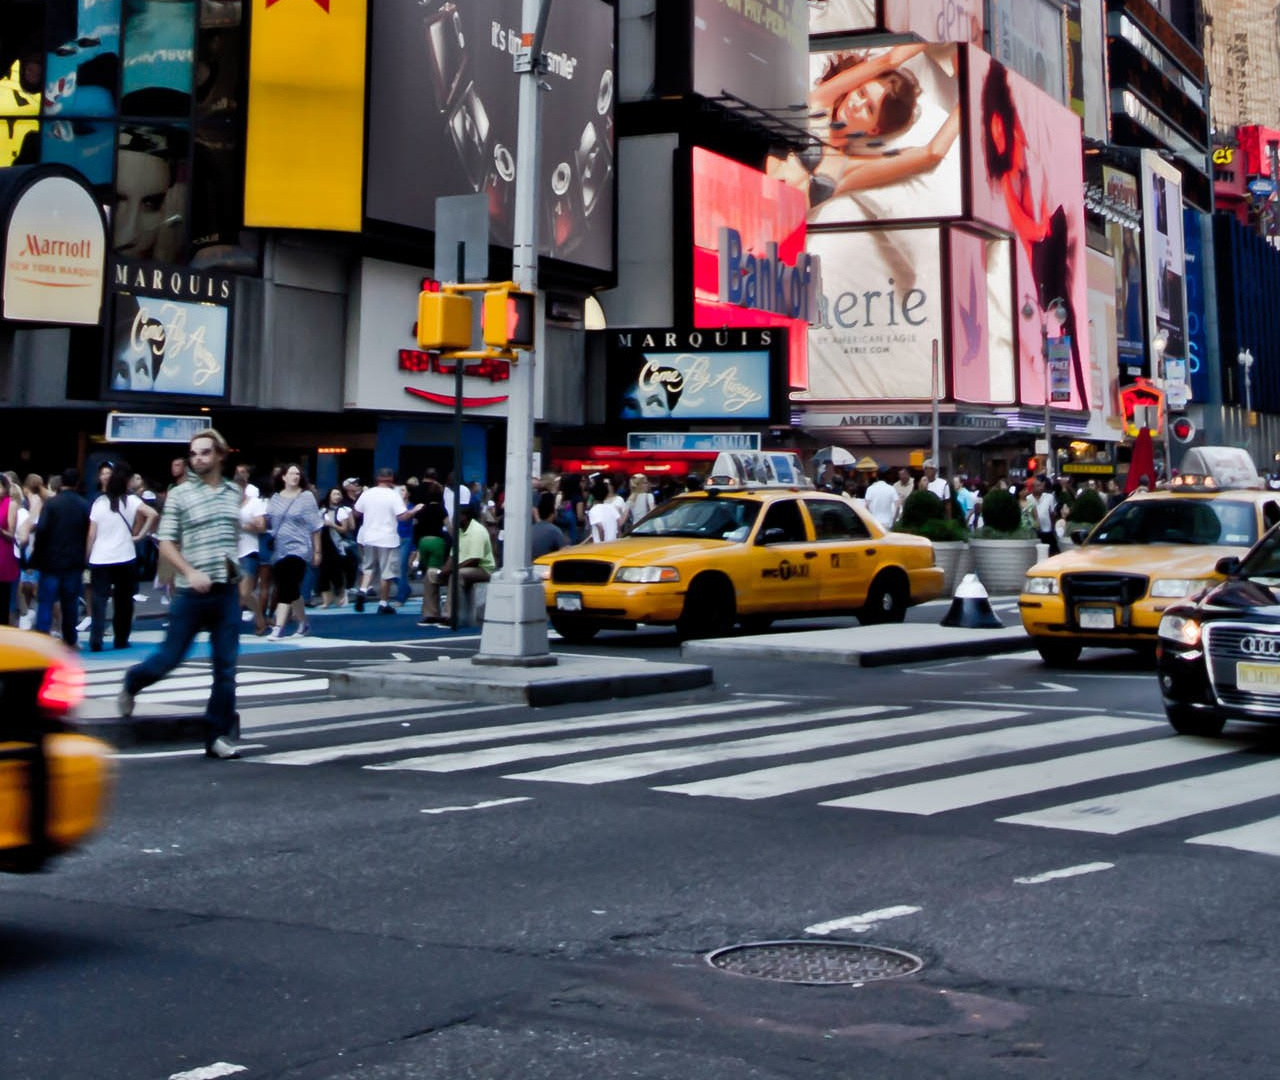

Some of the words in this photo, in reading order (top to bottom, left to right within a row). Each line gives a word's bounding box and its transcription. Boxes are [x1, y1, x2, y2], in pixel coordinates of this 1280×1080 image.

[19, 233, 91, 259] Marriott
[115, 264, 230, 298] MARQUIS
[718, 227, 787, 317] Bank
[619, 330, 771, 348] MARQUIS
[638, 360, 685, 393] Come
[840, 416, 914, 427] AMERICAN
